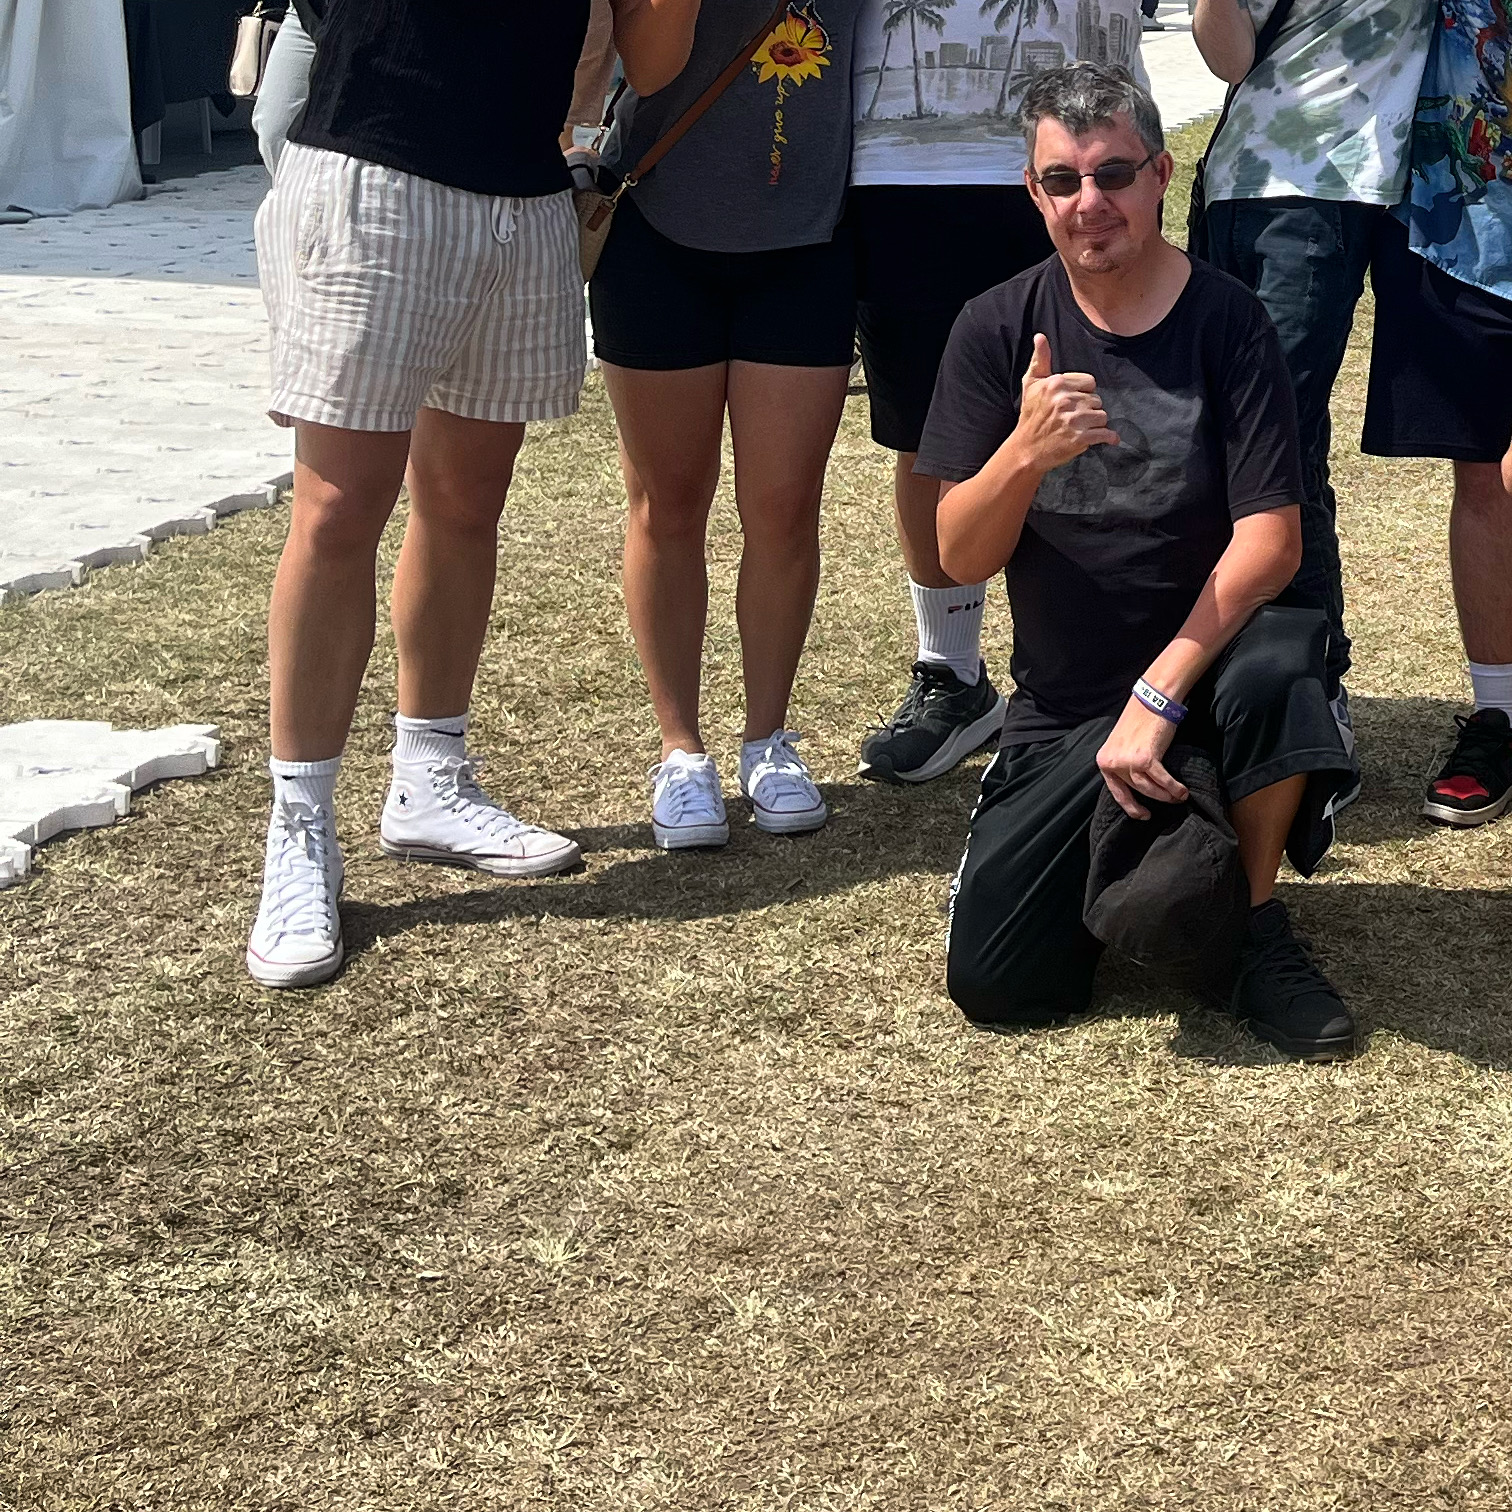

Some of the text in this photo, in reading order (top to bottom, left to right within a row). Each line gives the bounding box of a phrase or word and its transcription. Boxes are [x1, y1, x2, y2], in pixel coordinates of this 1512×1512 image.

[768, 84, 790, 185] never give up
[947, 595, 985, 614] FIL
